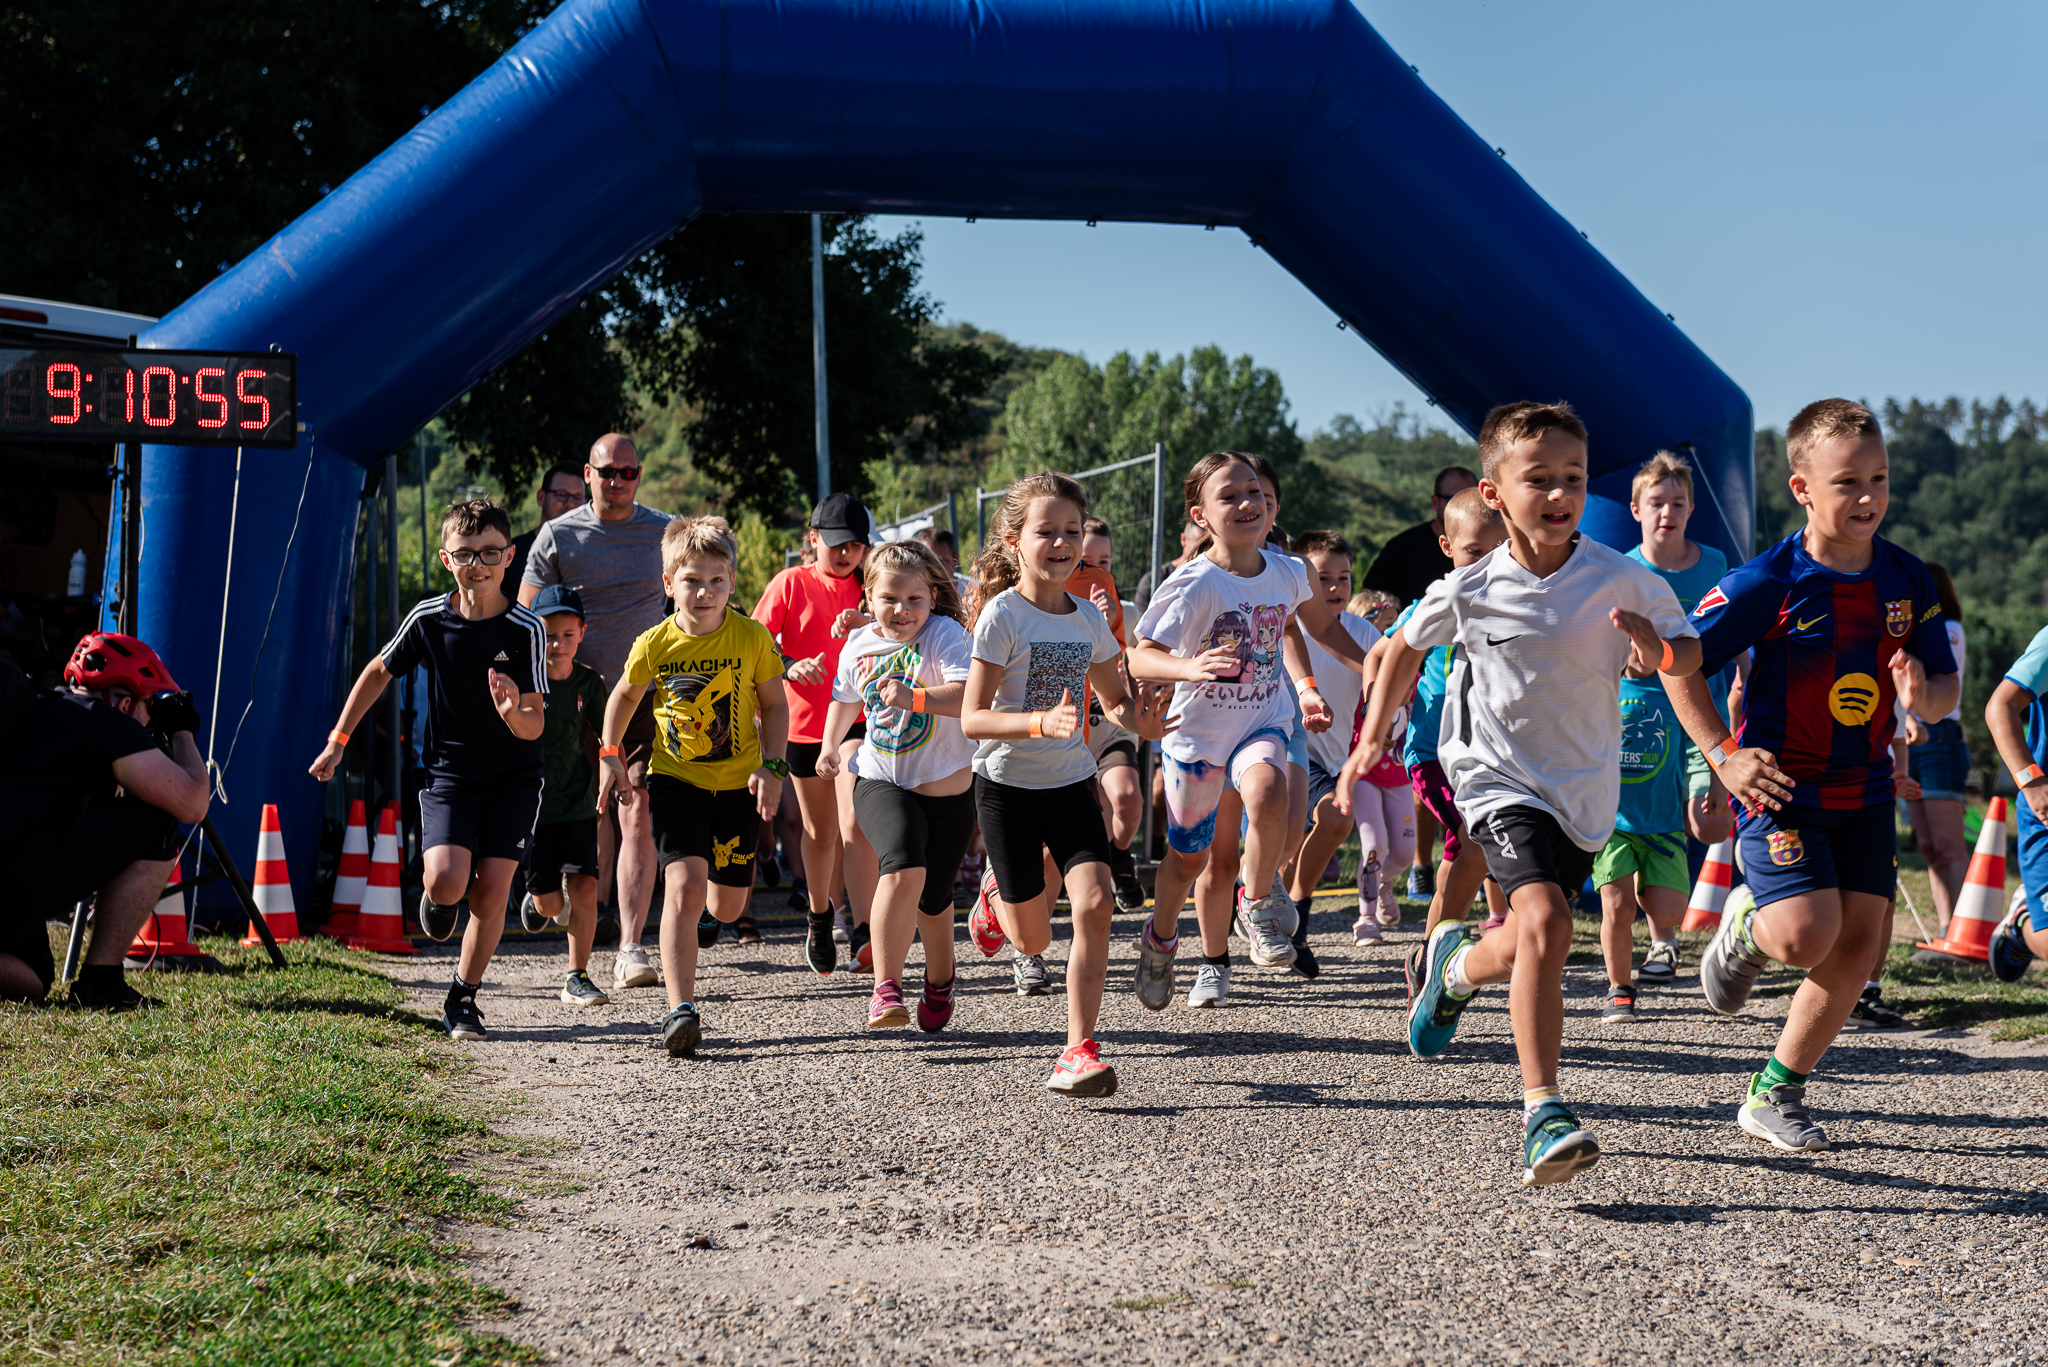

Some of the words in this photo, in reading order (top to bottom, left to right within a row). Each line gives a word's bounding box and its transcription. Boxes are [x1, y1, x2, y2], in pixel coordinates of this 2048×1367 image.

[657, 658, 742, 674] PIKACHU
[1038, 666, 1082, 677] POETIC
[1036, 680, 1067, 692] PLAY
